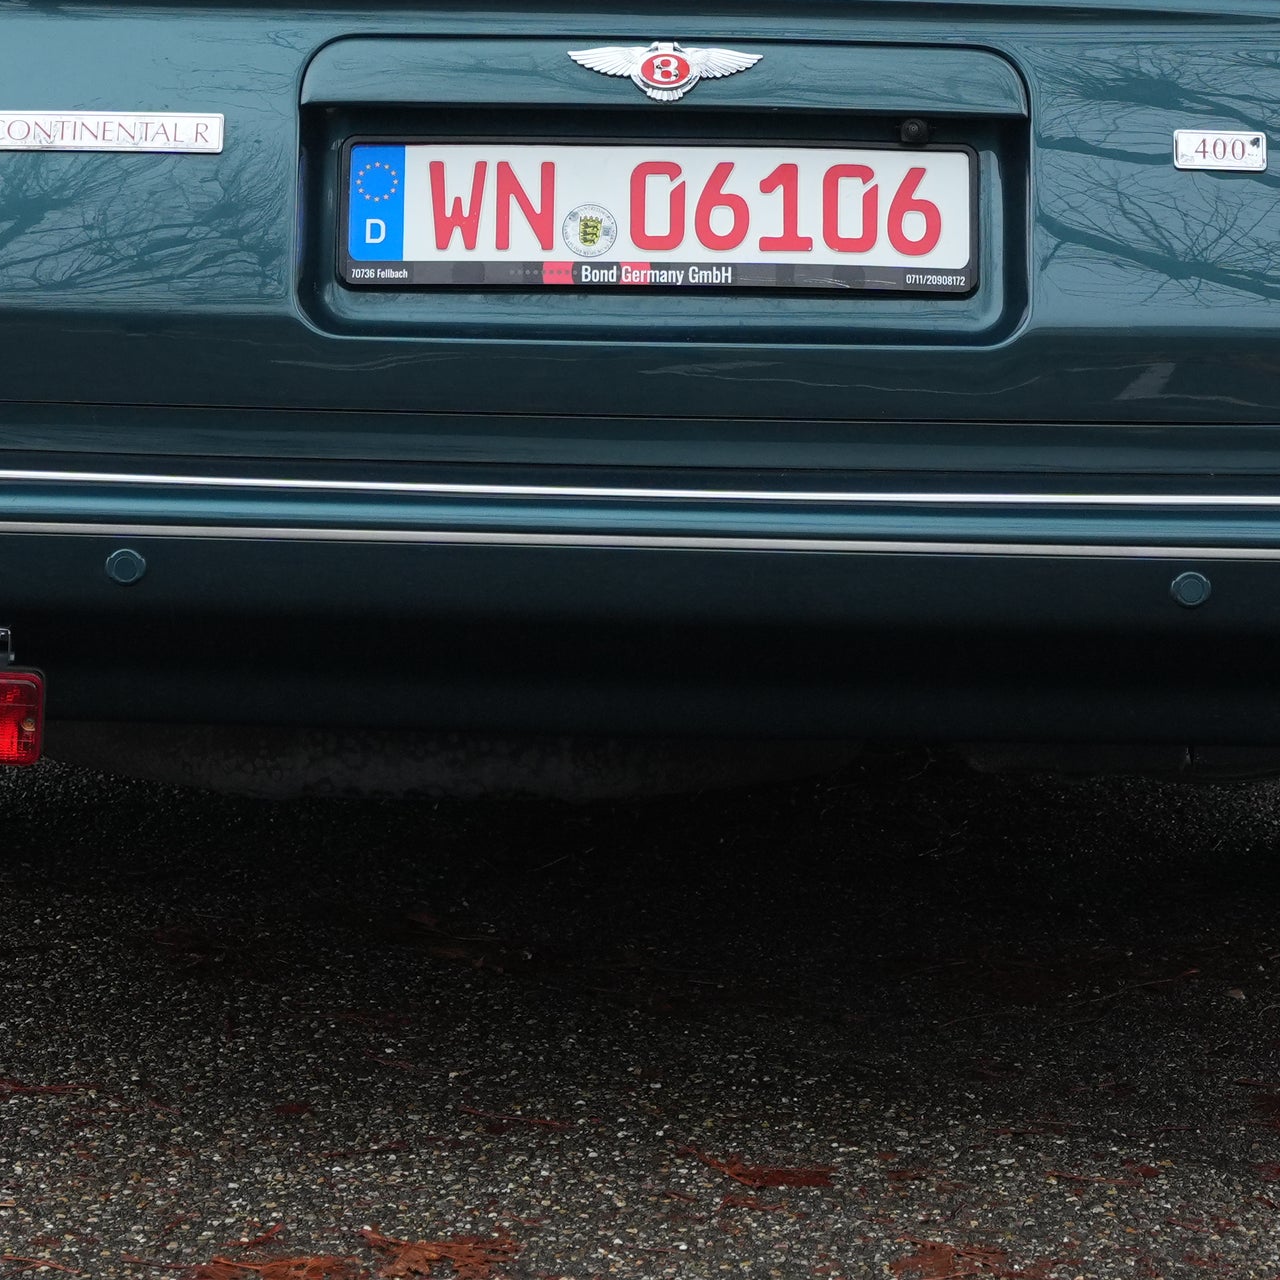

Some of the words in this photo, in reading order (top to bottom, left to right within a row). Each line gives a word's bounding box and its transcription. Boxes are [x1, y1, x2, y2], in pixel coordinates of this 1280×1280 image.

[194, 122, 209, 143] R
[1194, 138, 1246, 161] 400
[429, 161, 555, 251] WN
[629, 161, 942, 257] 06106
[365, 218, 386, 244] D
[351, 268, 375, 279] 70736
[376, 268, 408, 279] Fellbach
[581, 265, 617, 283] Bond
[621, 265, 684, 285] Germany
[688, 266, 732, 283] GmbH
[906, 274, 966, 286] 0711/20908172
